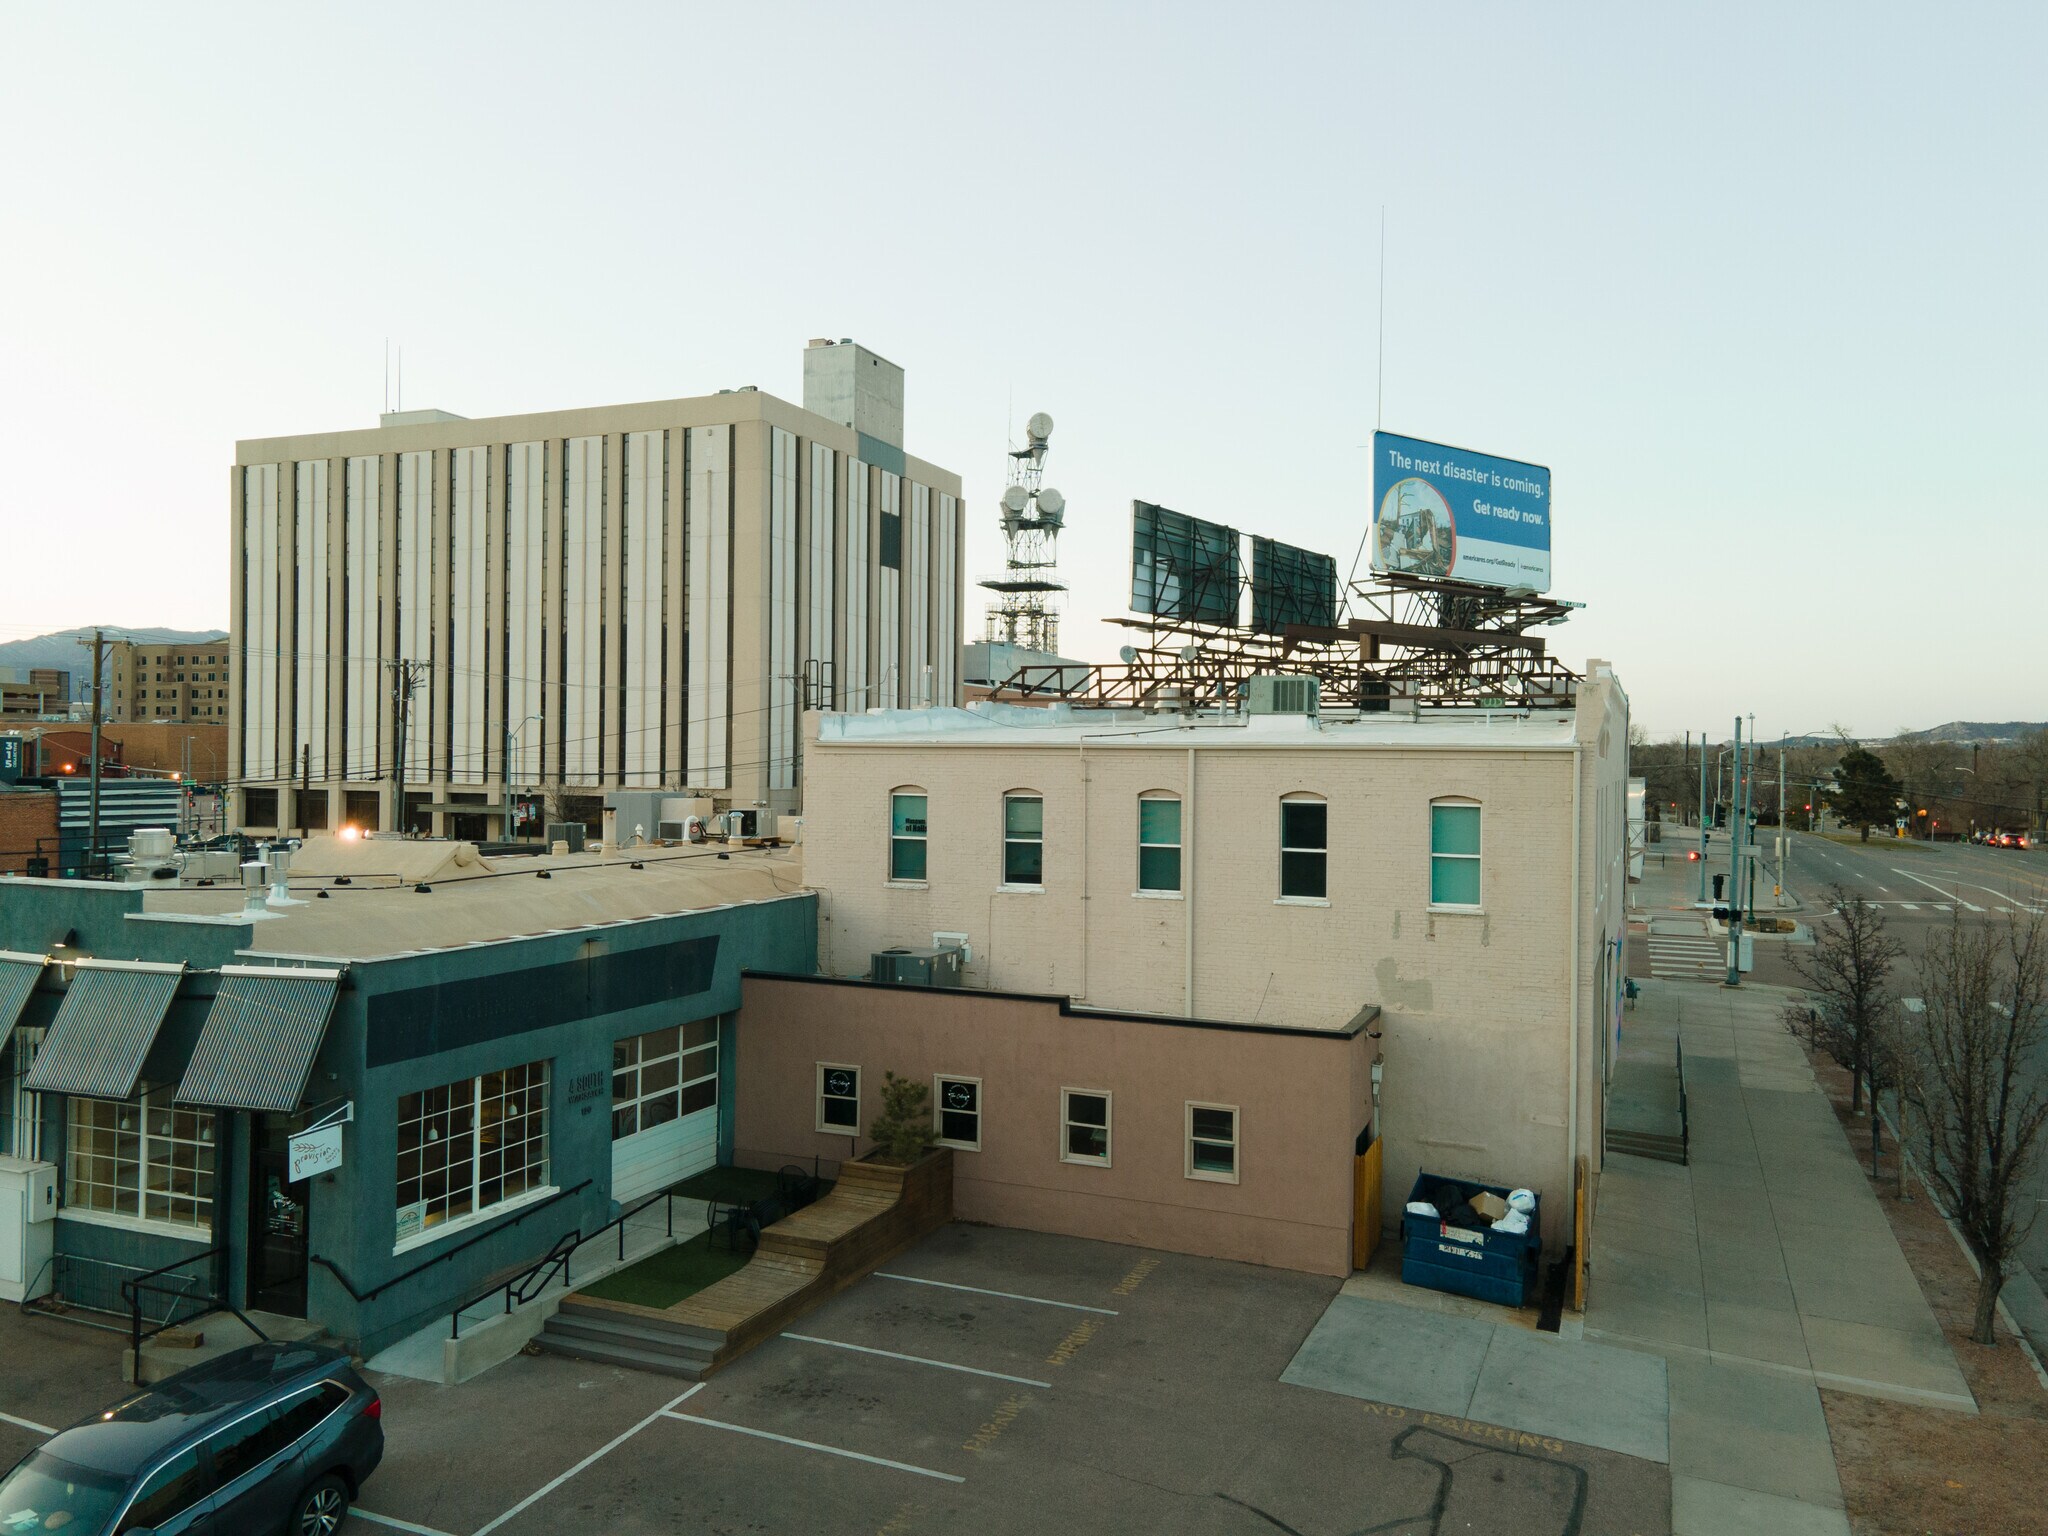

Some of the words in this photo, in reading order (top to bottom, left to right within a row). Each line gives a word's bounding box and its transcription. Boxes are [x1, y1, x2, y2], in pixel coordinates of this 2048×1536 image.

[1389, 450, 1411, 470] The
[1415, 458, 1440, 475] next
[1444, 462, 1489, 484] disaster
[1491, 471, 1501, 487] is
[1503, 478, 1544, 499] coming.
[1473, 499, 1491, 515] Get
[1493, 505, 1520, 522] ready
[1522, 512, 1544, 525] now.
[5, 741, 13, 768] 315
[905, 824, 912, 832] of
[568, 1078, 574, 1094] 4
[576, 1070, 603, 1092] SOUTH
[1363, 1403, 1406, 1419] NO
[1422, 1412, 1565, 1453] PARKING
